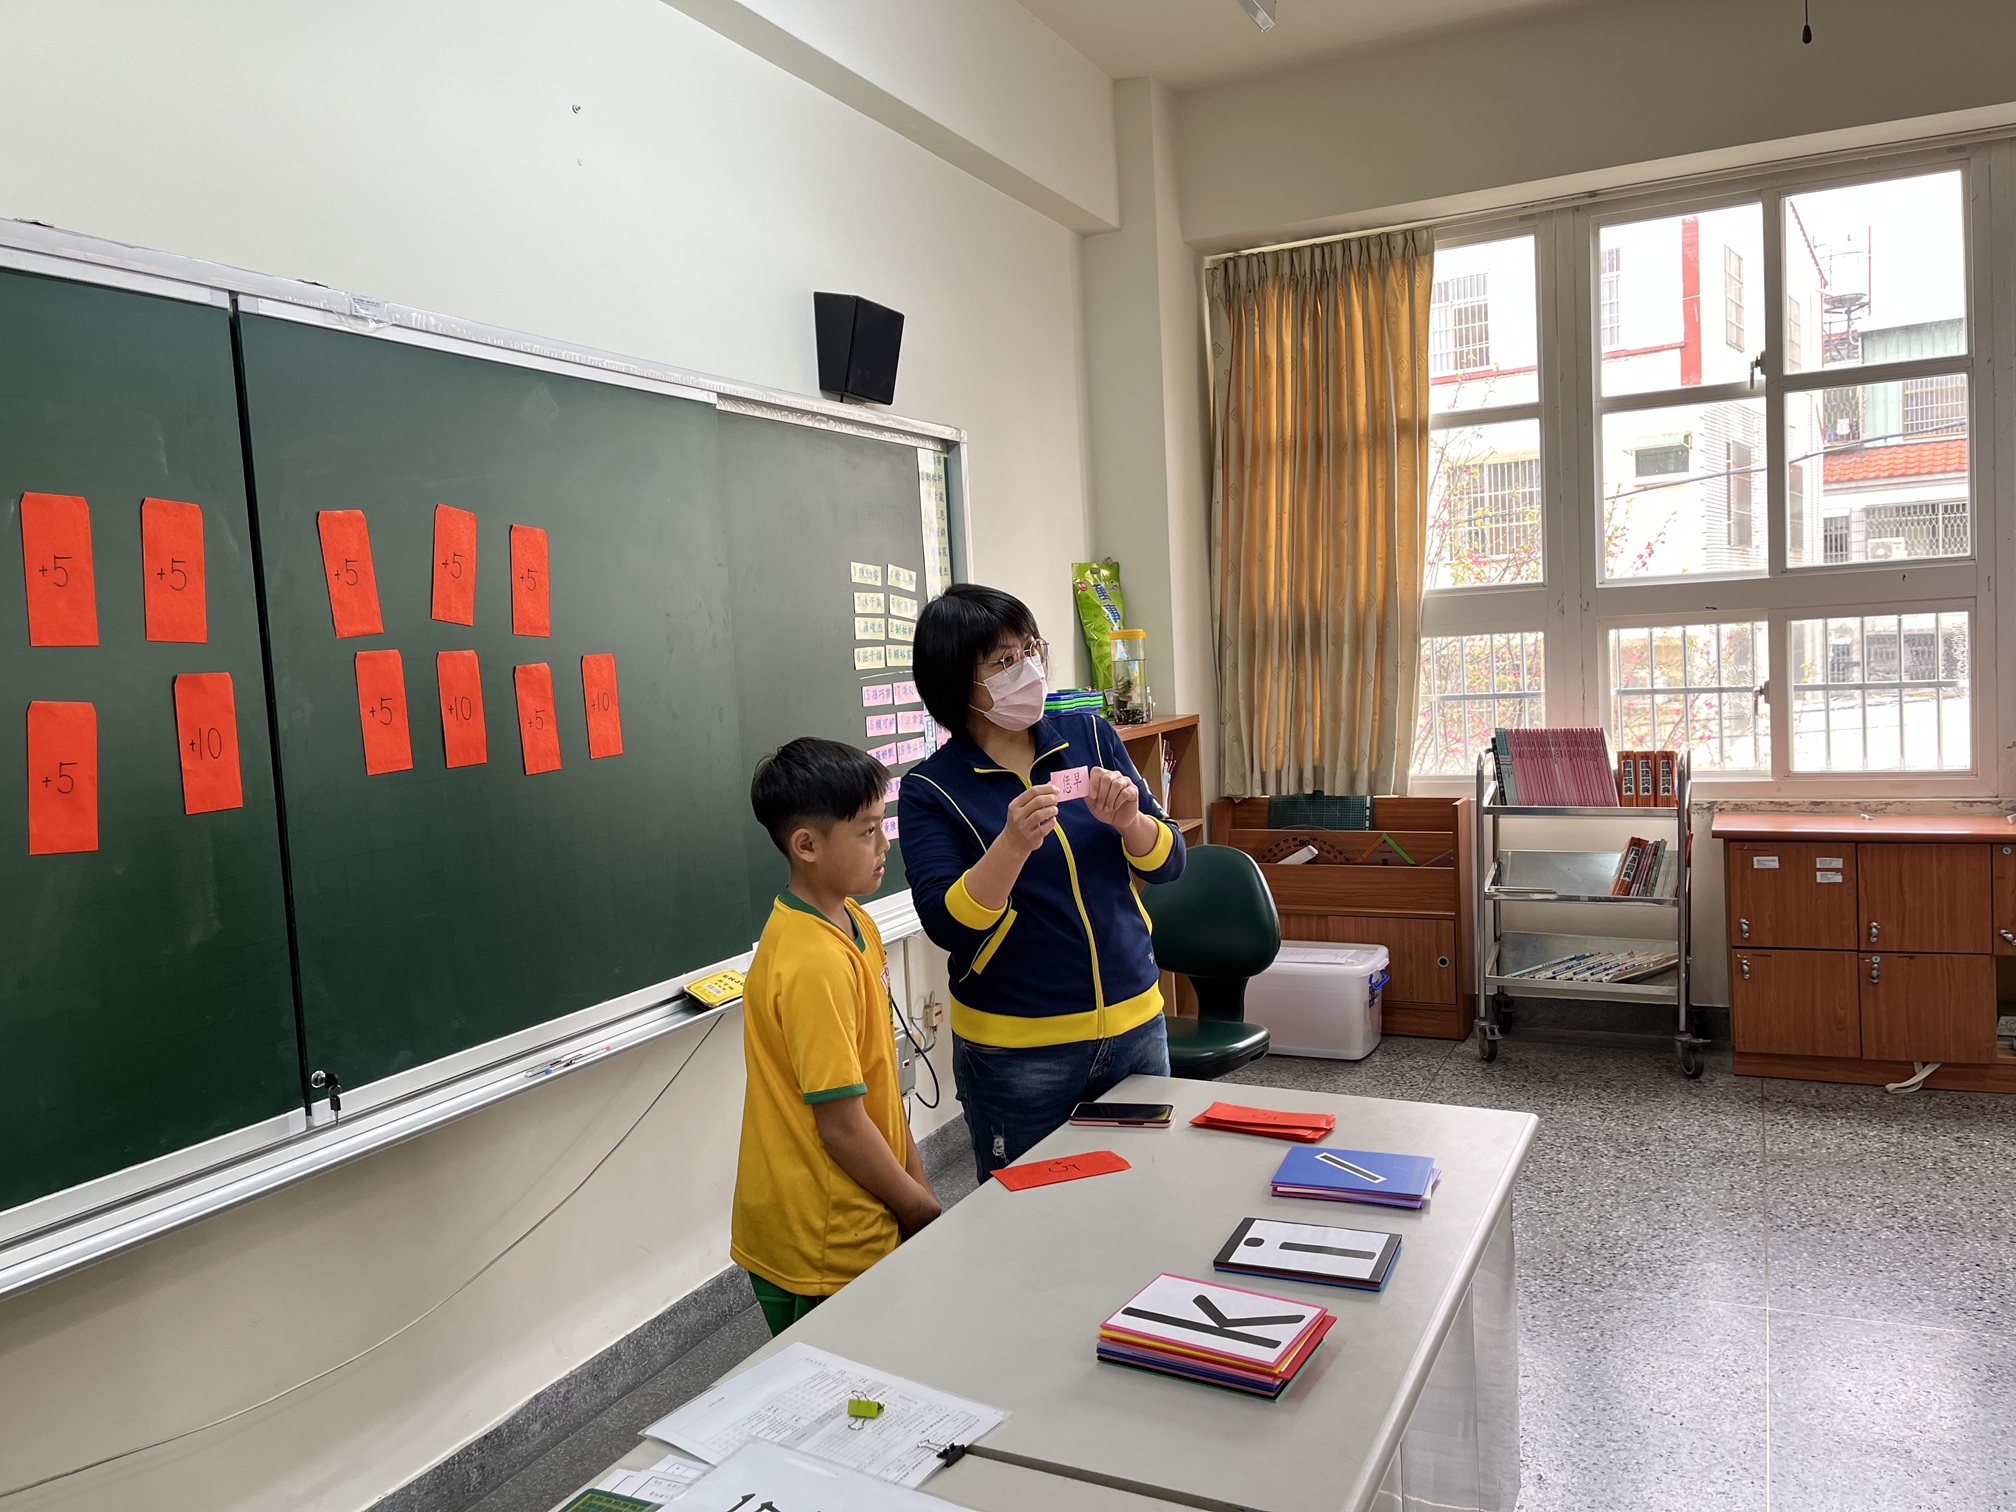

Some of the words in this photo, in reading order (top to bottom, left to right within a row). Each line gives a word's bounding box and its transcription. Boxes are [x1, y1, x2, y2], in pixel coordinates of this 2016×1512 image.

[39, 555, 73, 588] +5
[156, 558, 187, 592] +5
[335, 559, 360, 587] +5
[442, 552, 464, 580] +5
[520, 569, 537, 592] +5
[370, 697, 394, 726] +5
[448, 696, 472, 723] +10
[591, 691, 610, 713] +10
[528, 709, 545, 731] +5
[189, 727, 222, 760] +10
[42, 762, 75, 794] +5
[1641, 761, 1650, 794] 國語詞典
[1661, 761, 1671, 794] 國語詞典
[1049, 1161, 1081, 1173] +5
